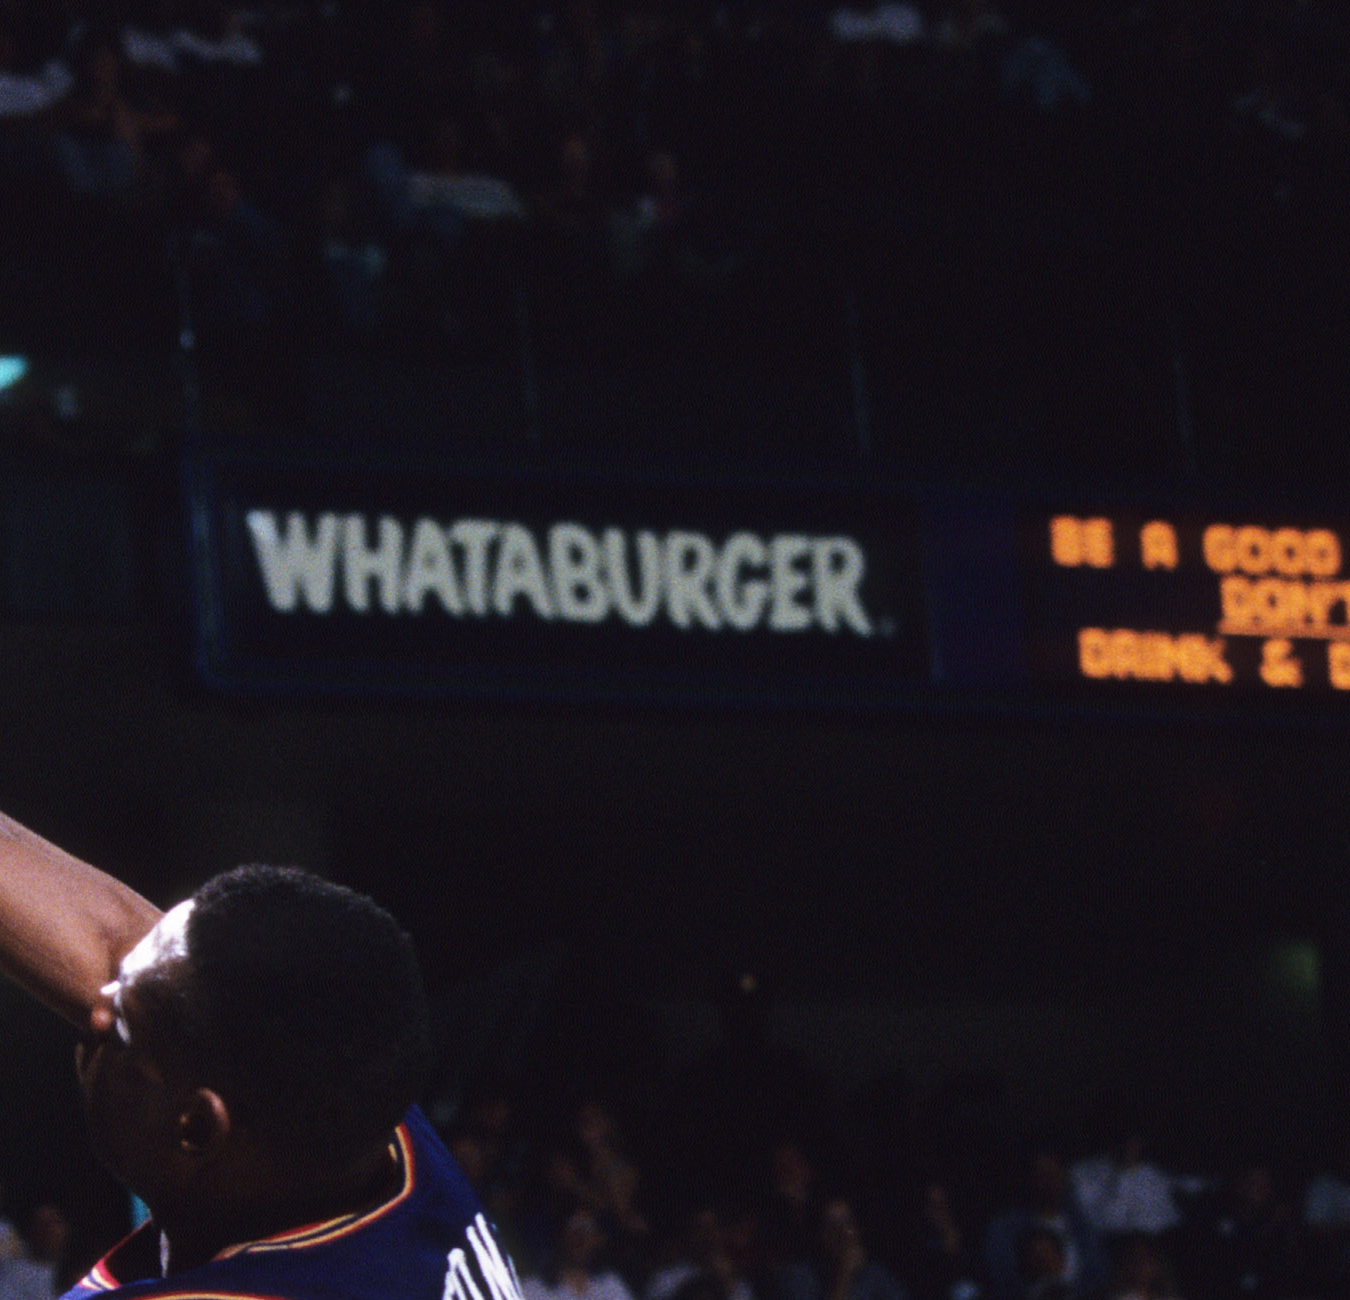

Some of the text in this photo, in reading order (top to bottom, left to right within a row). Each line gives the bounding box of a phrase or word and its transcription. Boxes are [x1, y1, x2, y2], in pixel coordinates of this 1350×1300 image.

[248, 510, 873, 636] WHATABURGER
[1050, 514, 1341, 577] BE A GOOD
[1077, 627, 1233, 684] DRINK
[1260, 637, 1303, 688] &
